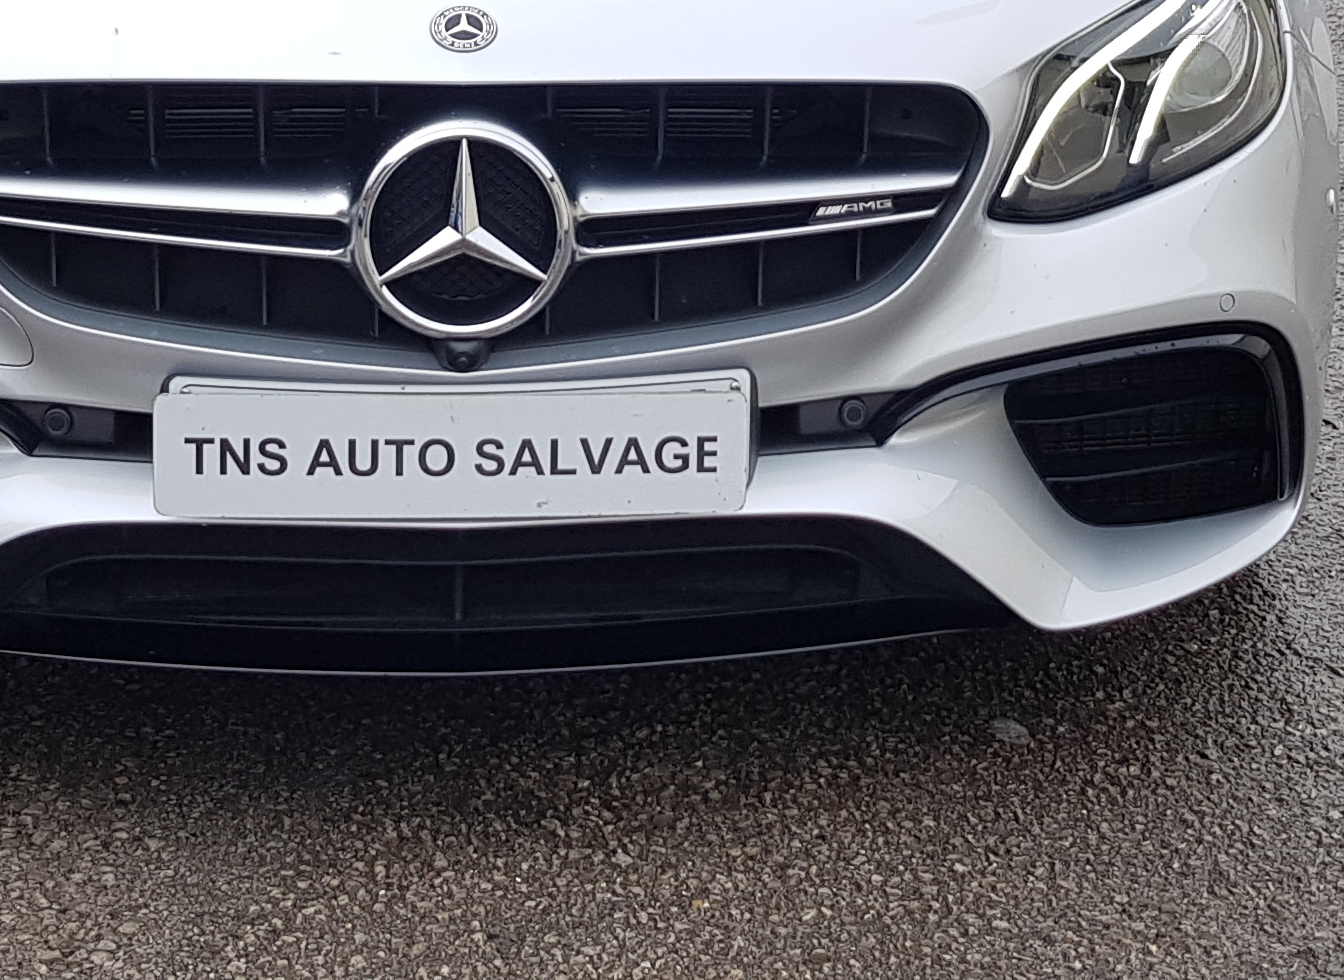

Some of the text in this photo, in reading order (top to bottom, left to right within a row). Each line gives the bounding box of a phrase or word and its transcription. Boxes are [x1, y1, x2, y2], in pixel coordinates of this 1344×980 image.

[840, 198, 893, 215] AMG
[184, 435, 719, 477] TNS AUTO SALVAGE
